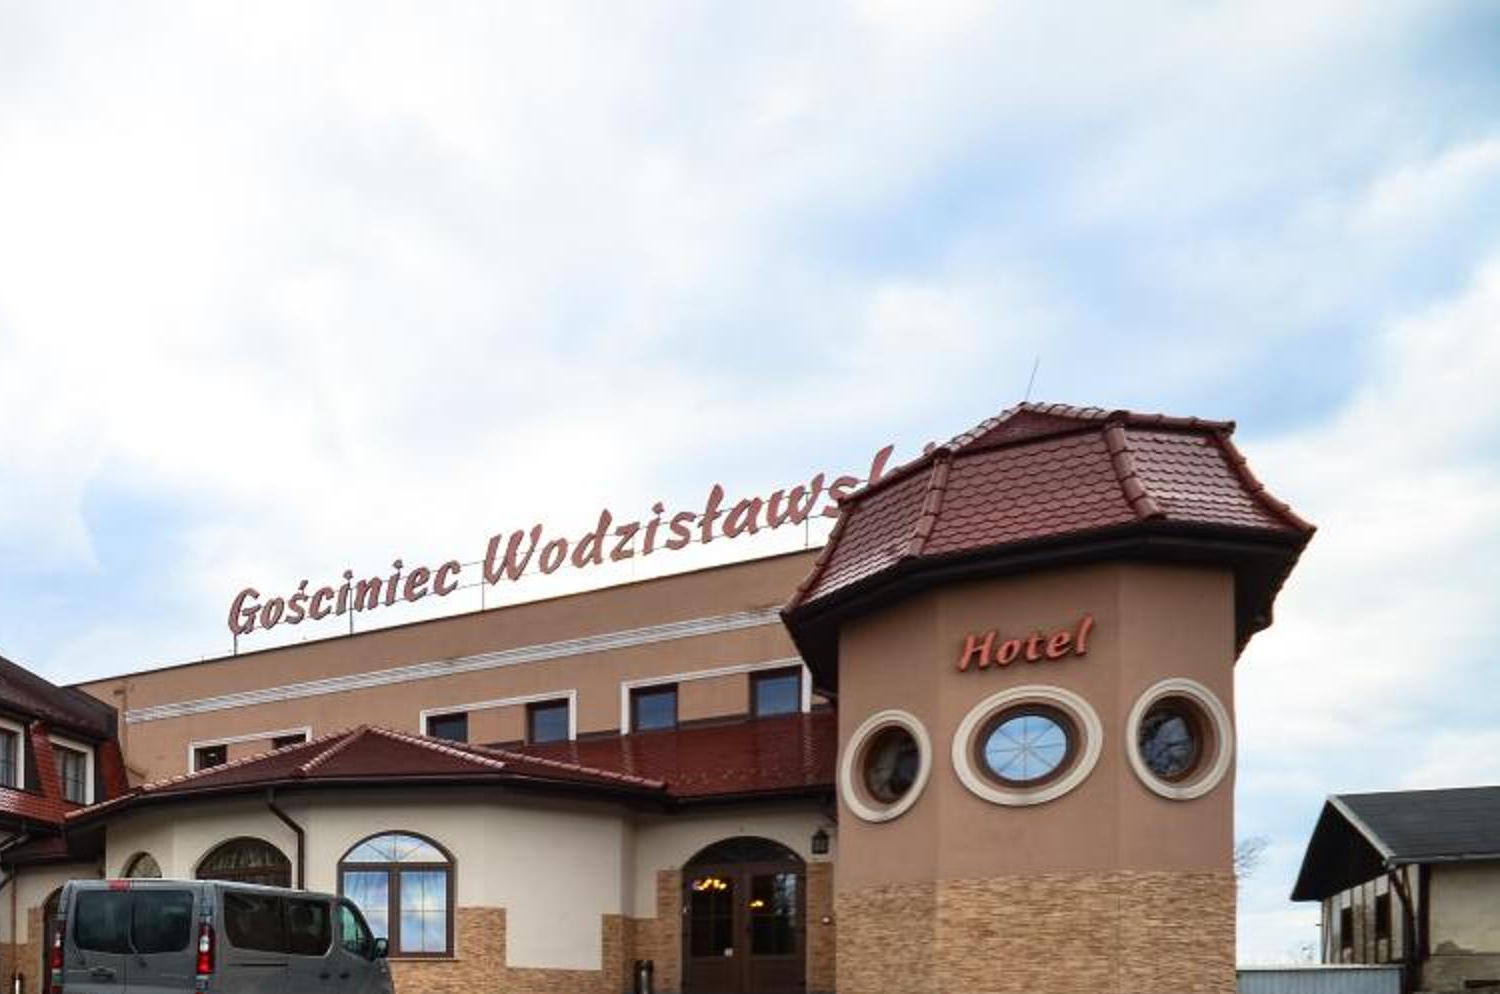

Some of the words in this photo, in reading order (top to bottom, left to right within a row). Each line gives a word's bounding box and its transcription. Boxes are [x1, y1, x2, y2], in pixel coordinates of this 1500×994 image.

[228, 559, 461, 636] Gościniec
[484, 444, 935, 585] Wodzisławs
[957, 614, 1093, 672] Hotel
